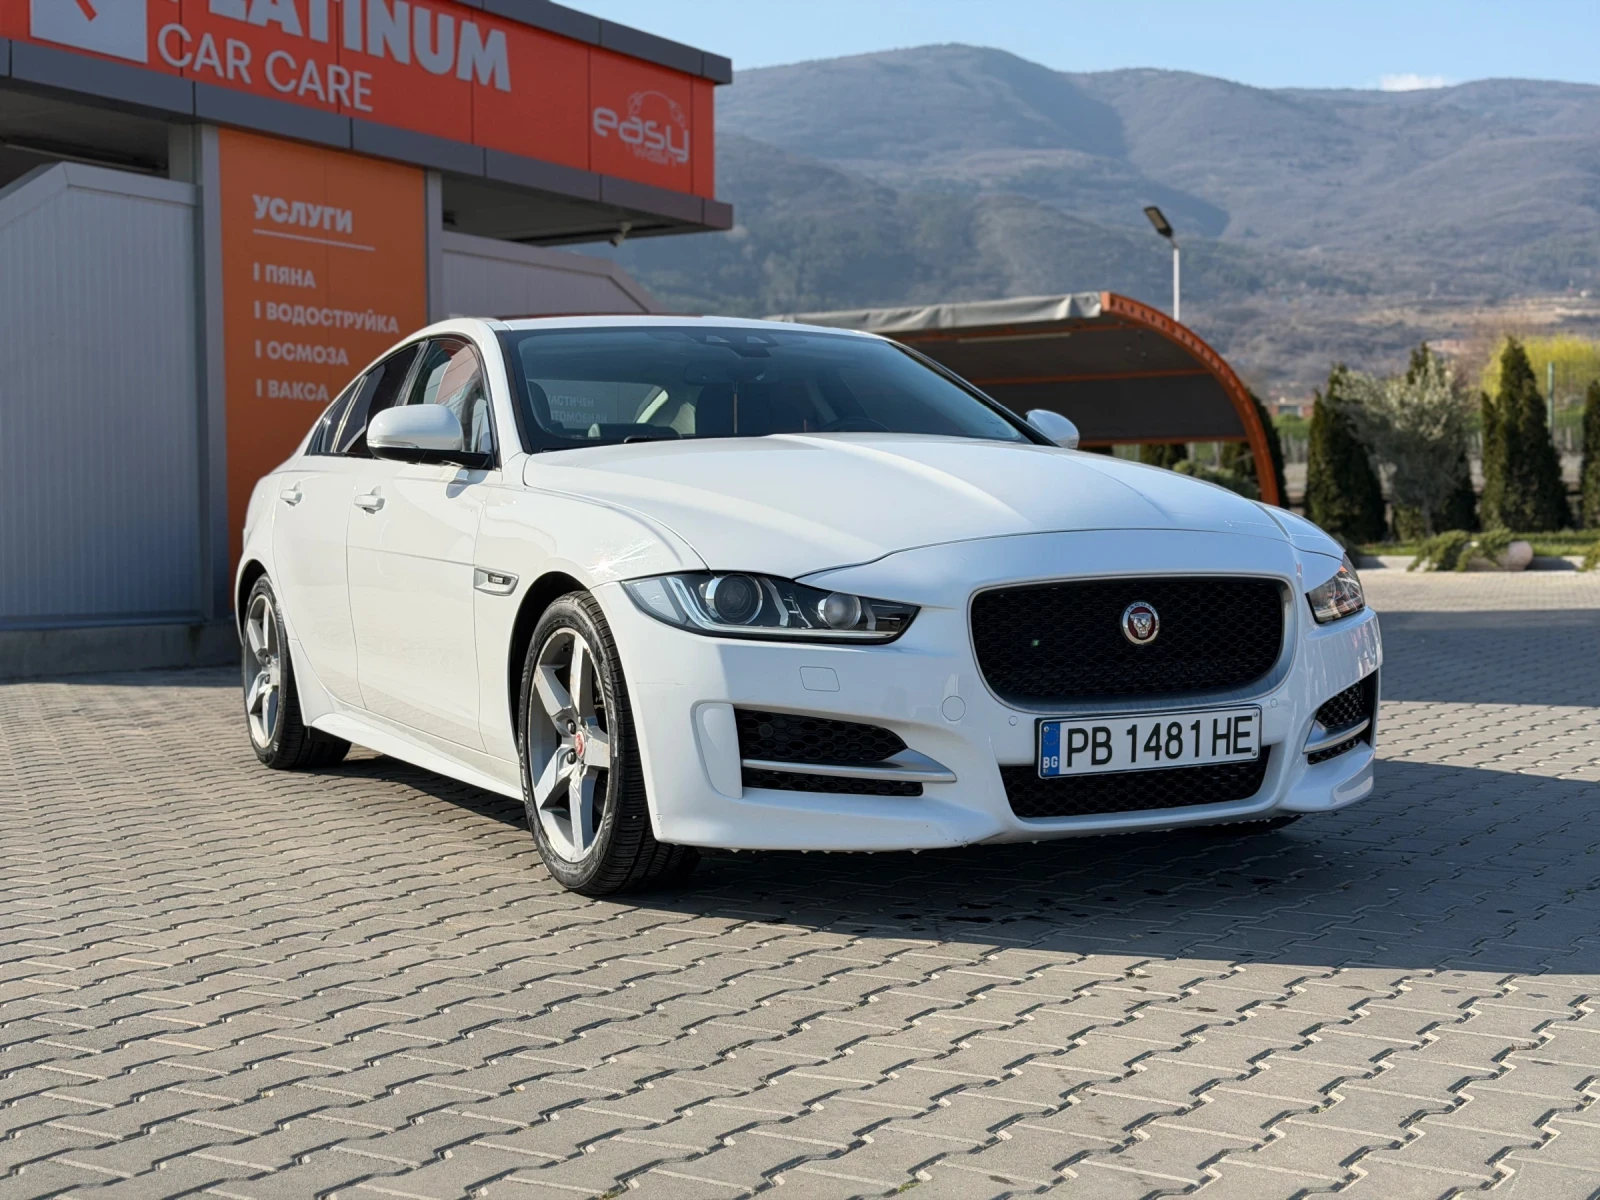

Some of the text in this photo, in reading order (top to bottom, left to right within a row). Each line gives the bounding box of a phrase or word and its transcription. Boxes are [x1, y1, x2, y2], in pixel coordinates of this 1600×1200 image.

[157, 23, 373, 112] CAR CARE
[593, 107, 689, 164] easy
[252, 194, 352, 234] УСЛУГИ
[266, 264, 316, 288] ПЯНА
[266, 302, 399, 333] ВОДОСТРУЙКА
[267, 341, 349, 366] ОСМОЗА
[268, 380, 330, 401] ВАКСА
[1067, 715, 1253, 768] PB 1481 HE
[1042, 755, 1058, 769] BG
